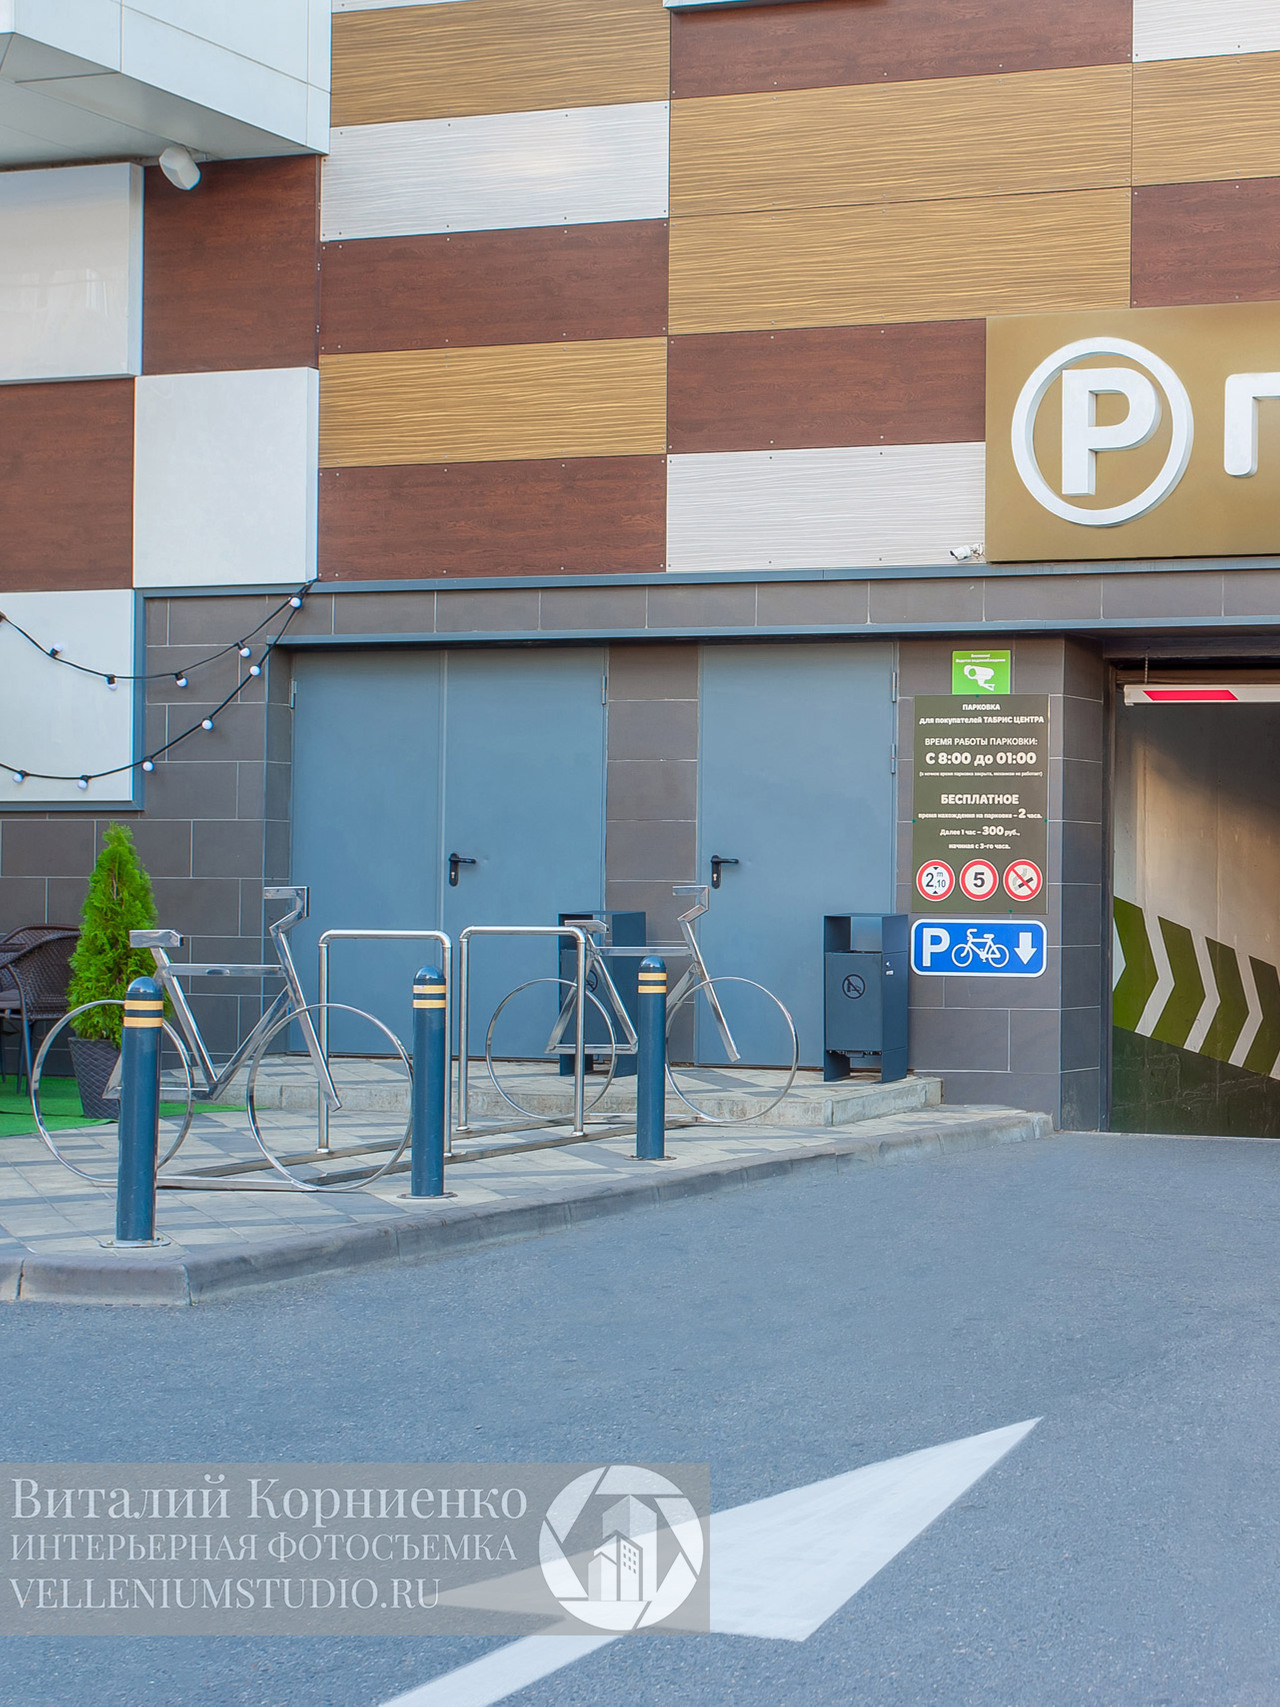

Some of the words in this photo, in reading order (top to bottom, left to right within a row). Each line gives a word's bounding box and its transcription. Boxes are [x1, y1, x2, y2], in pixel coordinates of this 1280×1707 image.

[962, 703, 1001, 711] ПАРКОВКА
[919, 717, 935, 725] для
[935, 717, 982, 726] покупателей
[983, 716, 1013, 724] ТАБРИС
[1014, 716, 1045, 725] ЦЕНТРА
[925, 738, 953, 746] ВРЕМЯ
[954, 738, 988, 746] РАБОТЫ
[989, 737, 1038, 746] ПАРКОВКИ:
[938, 752, 972, 765] 8:00
[974, 754, 994, 767] до
[996, 752, 1037, 765] 01:00
[940, 793, 1020, 805] БЕСПЛАТНОЕ
[1018, 808, 1027, 819] 2
[982, 826, 1004, 836] 300
[972, 872, 985, 888] 5
[922, 927, 950, 967] P
